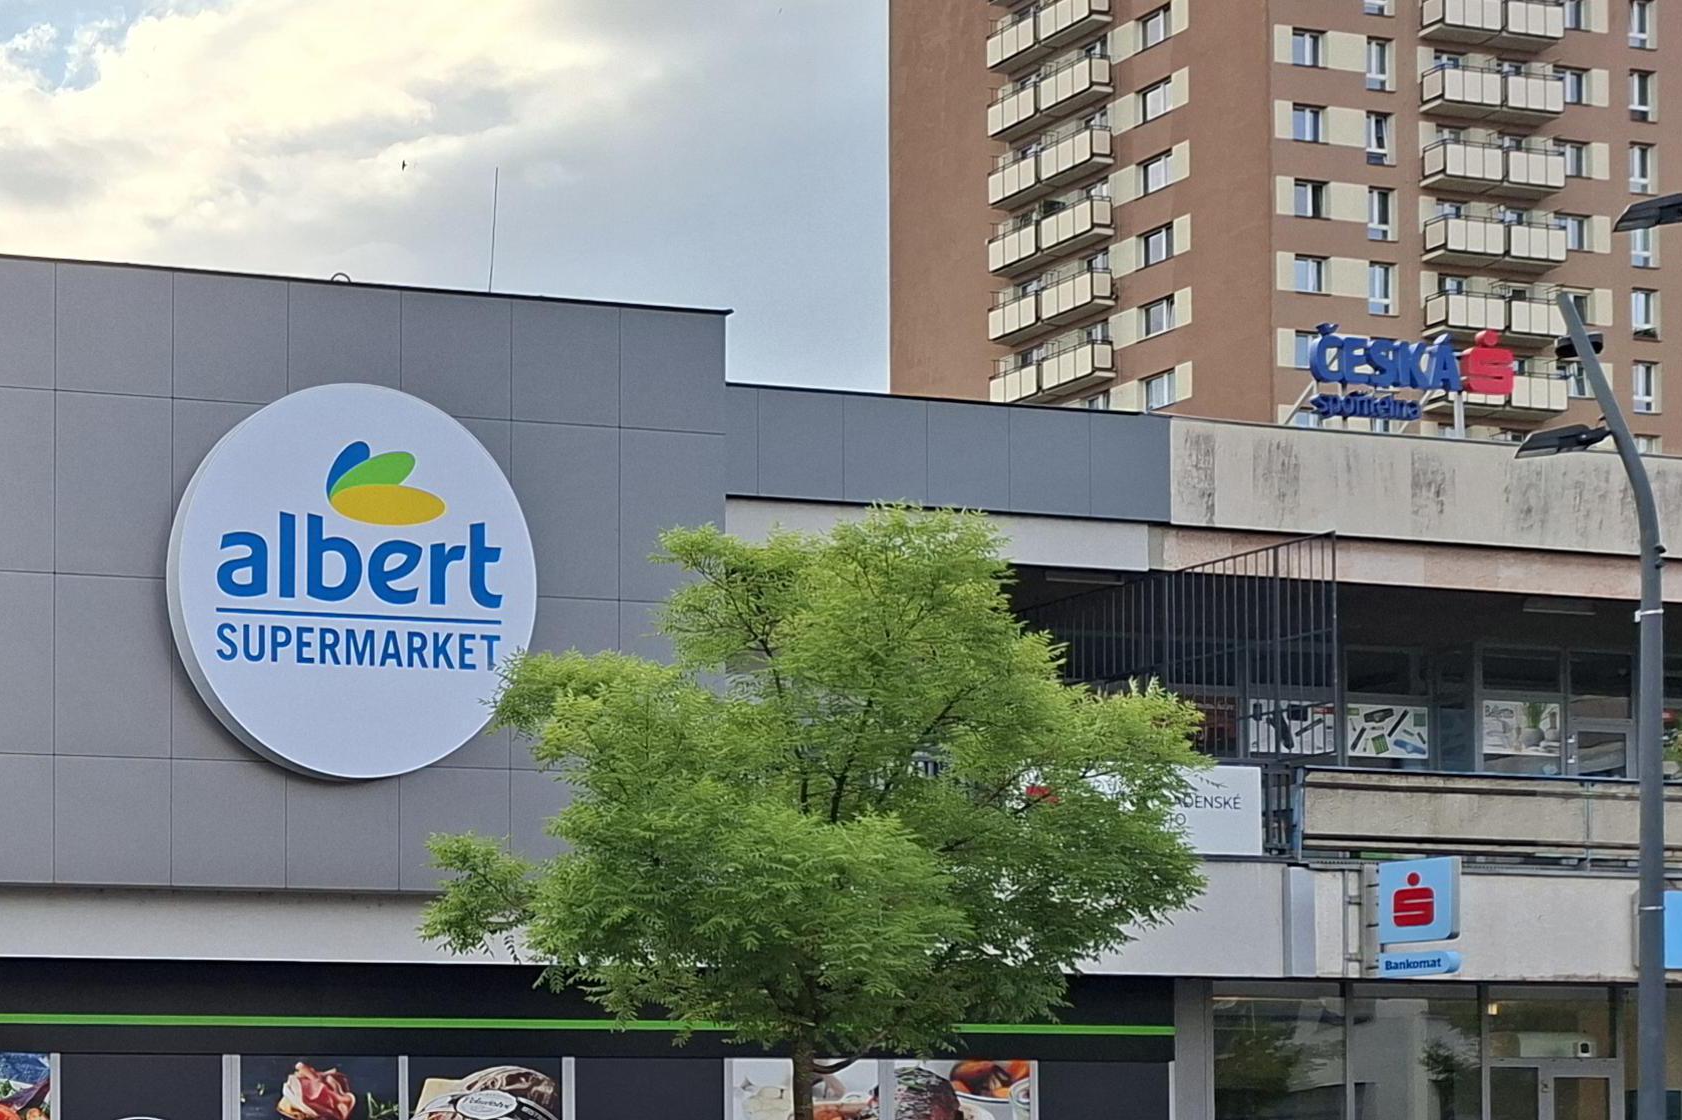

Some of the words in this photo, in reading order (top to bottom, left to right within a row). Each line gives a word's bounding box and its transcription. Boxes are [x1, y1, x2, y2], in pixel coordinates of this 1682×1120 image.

[1310, 322, 1461, 392] ČESKÁ
[216, 511, 503, 609] albert
[216, 622, 502, 671] SUPERMARKET
[1384, 958, 1443, 971] Bankomat
